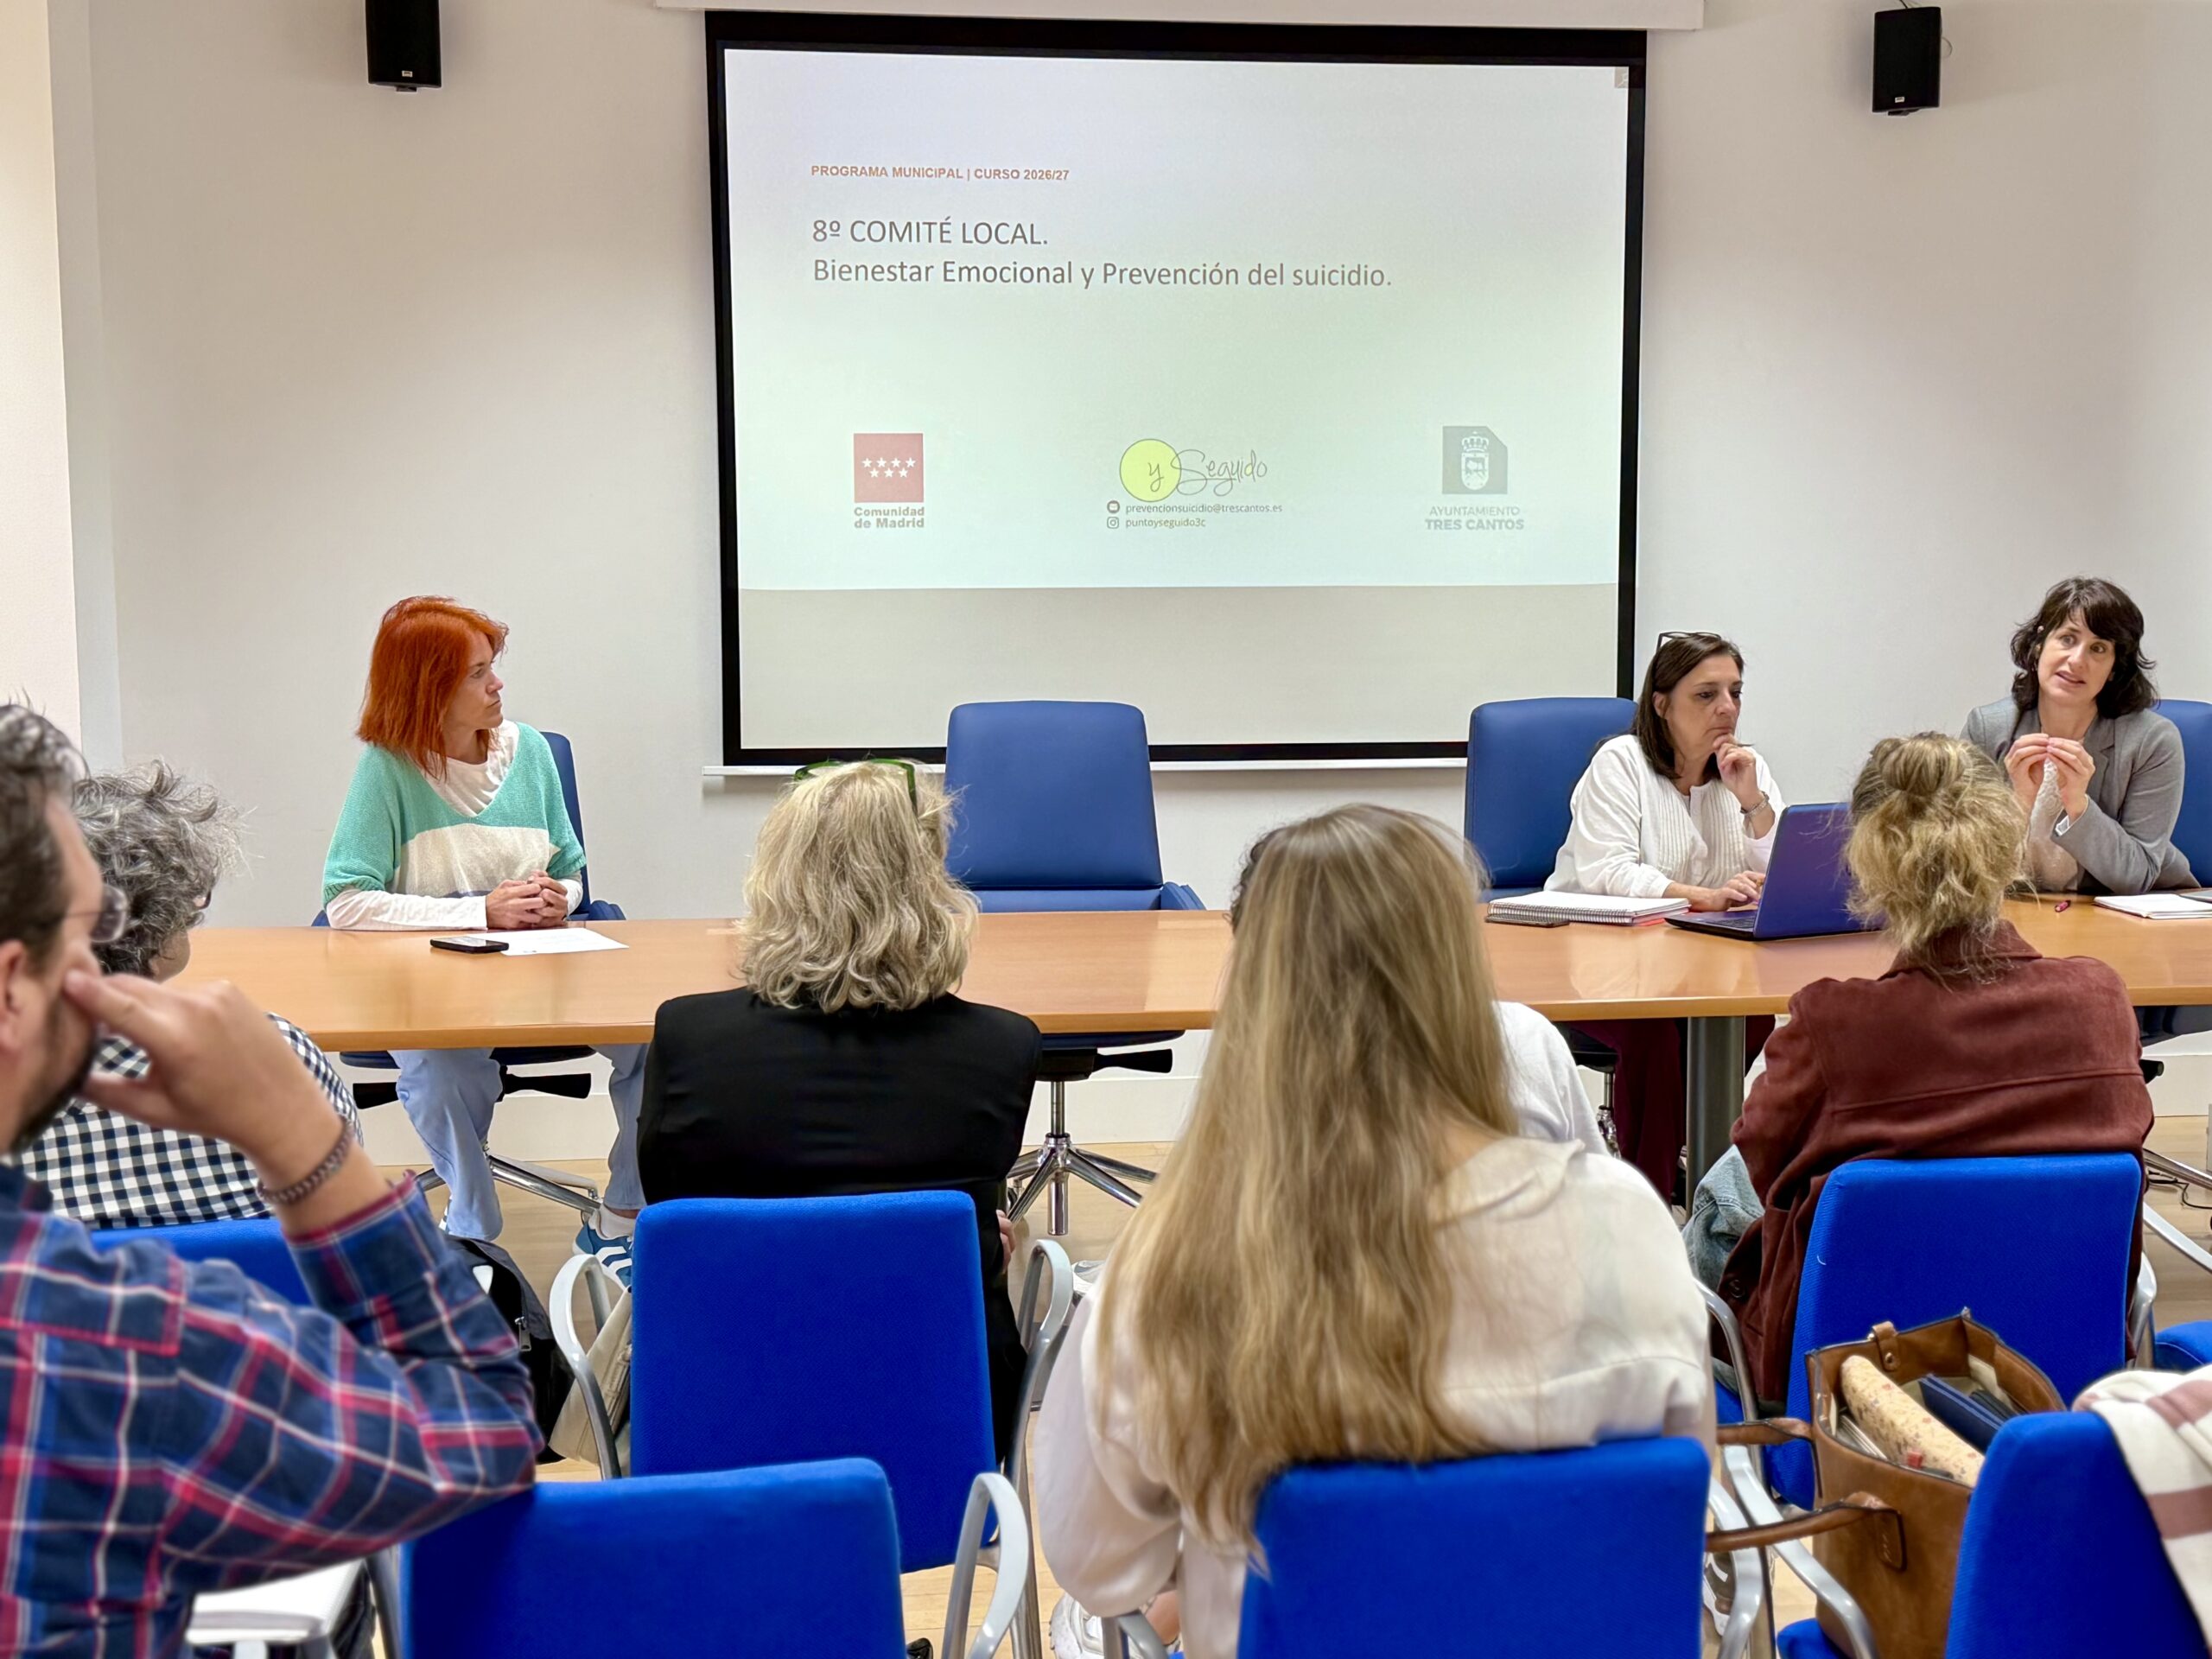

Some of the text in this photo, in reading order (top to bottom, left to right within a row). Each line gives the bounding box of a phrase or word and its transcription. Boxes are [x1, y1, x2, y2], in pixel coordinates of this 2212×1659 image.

[811, 165, 888, 178] PROGRAMA
[892, 167, 963, 179] MUNICIPAL
[974, 168, 1020, 180] CURSO
[1024, 169, 1070, 181] 2026/27
[812, 215, 1048, 245] 8º COMITÉ LOCAL.
[814, 258, 1392, 289] Bienestar Emocional y Prevención del suicidio.
[1147, 448, 1268, 497] y Seguido
[854, 506, 925, 517] Comunidad
[1126, 503, 1283, 515] prevencionsuicidio@trescantos.es
[1429, 505, 1521, 516] AYUNTAMIENTO
[854, 518, 925, 529] de Madrid
[1126, 518, 1205, 529] puntoyseguido3c
[1424, 518, 1525, 531] TRES CANTOS
